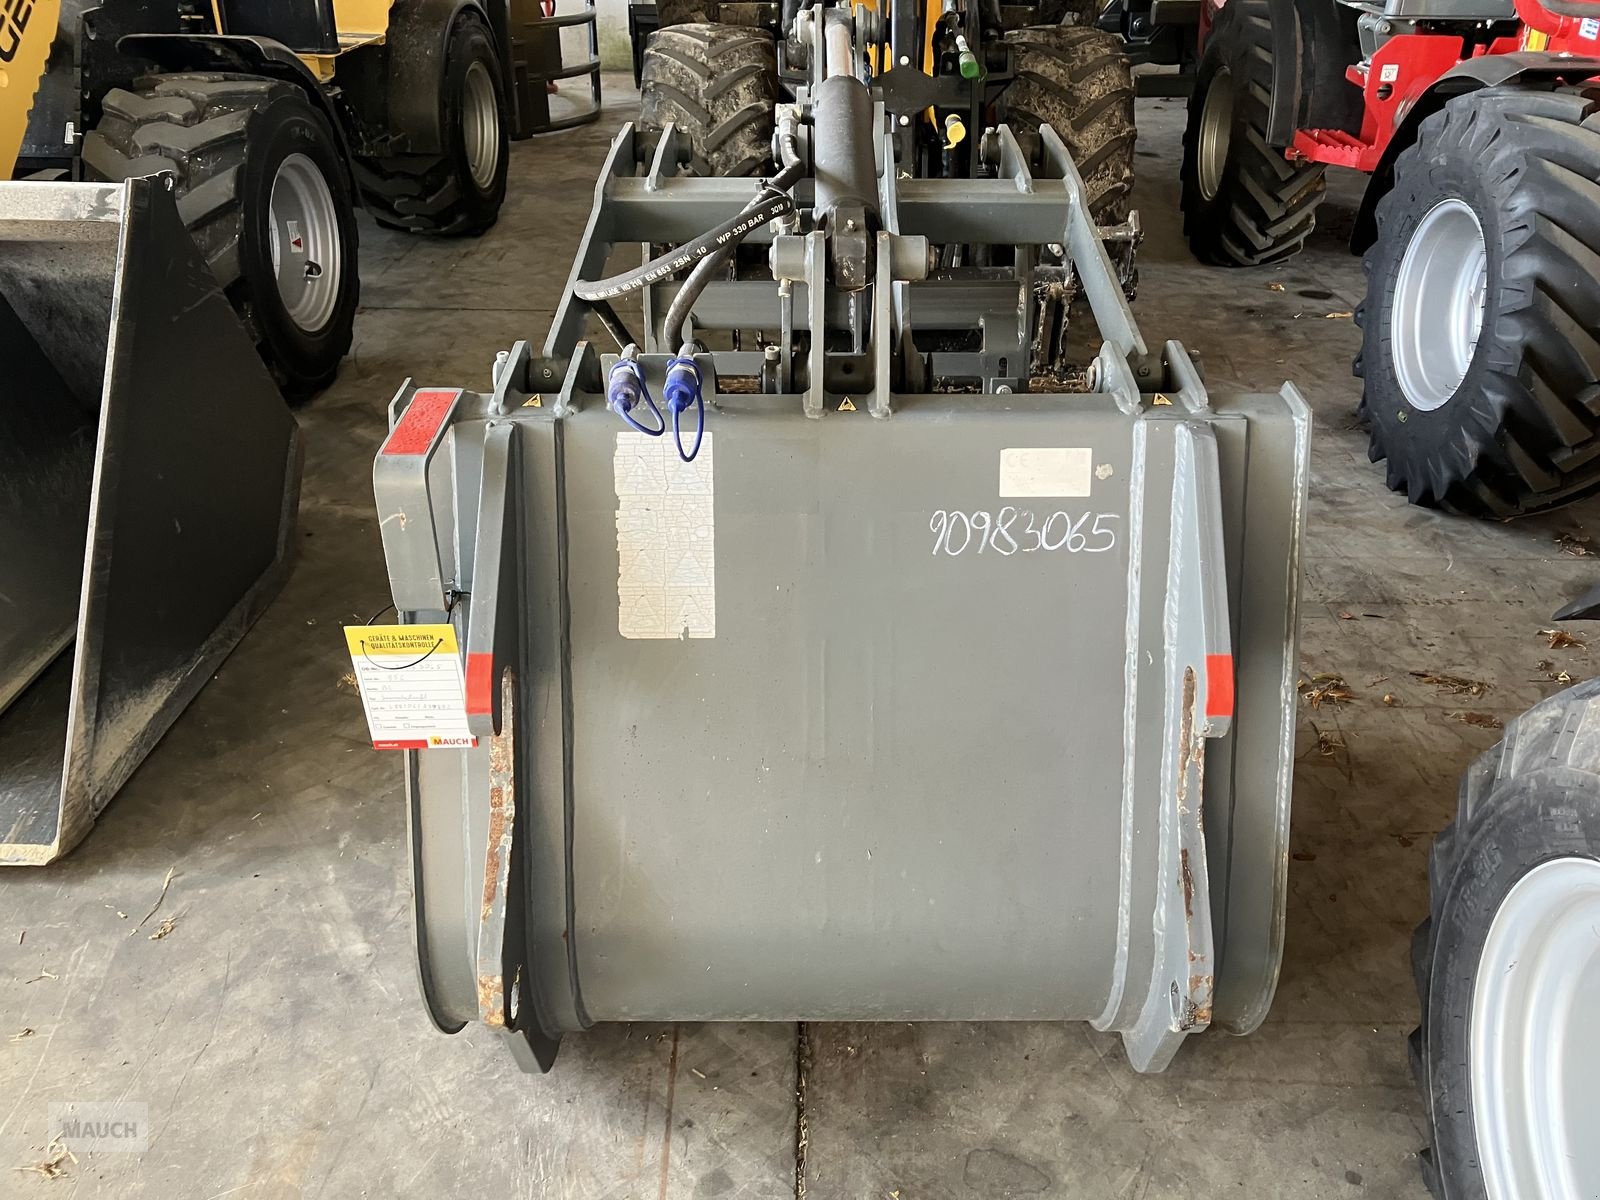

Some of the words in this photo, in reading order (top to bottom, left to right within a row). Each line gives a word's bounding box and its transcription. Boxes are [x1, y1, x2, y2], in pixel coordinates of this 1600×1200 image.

[645, 272, 658, 282] EN
[716, 232, 731, 245] WP
[732, 223, 747, 236] 330
[747, 213, 765, 228] BAR
[930, 506, 1121, 556] 90983065
[398, 633, 435, 641] MASCHINEN
[433, 738, 469, 746] MAUCH
